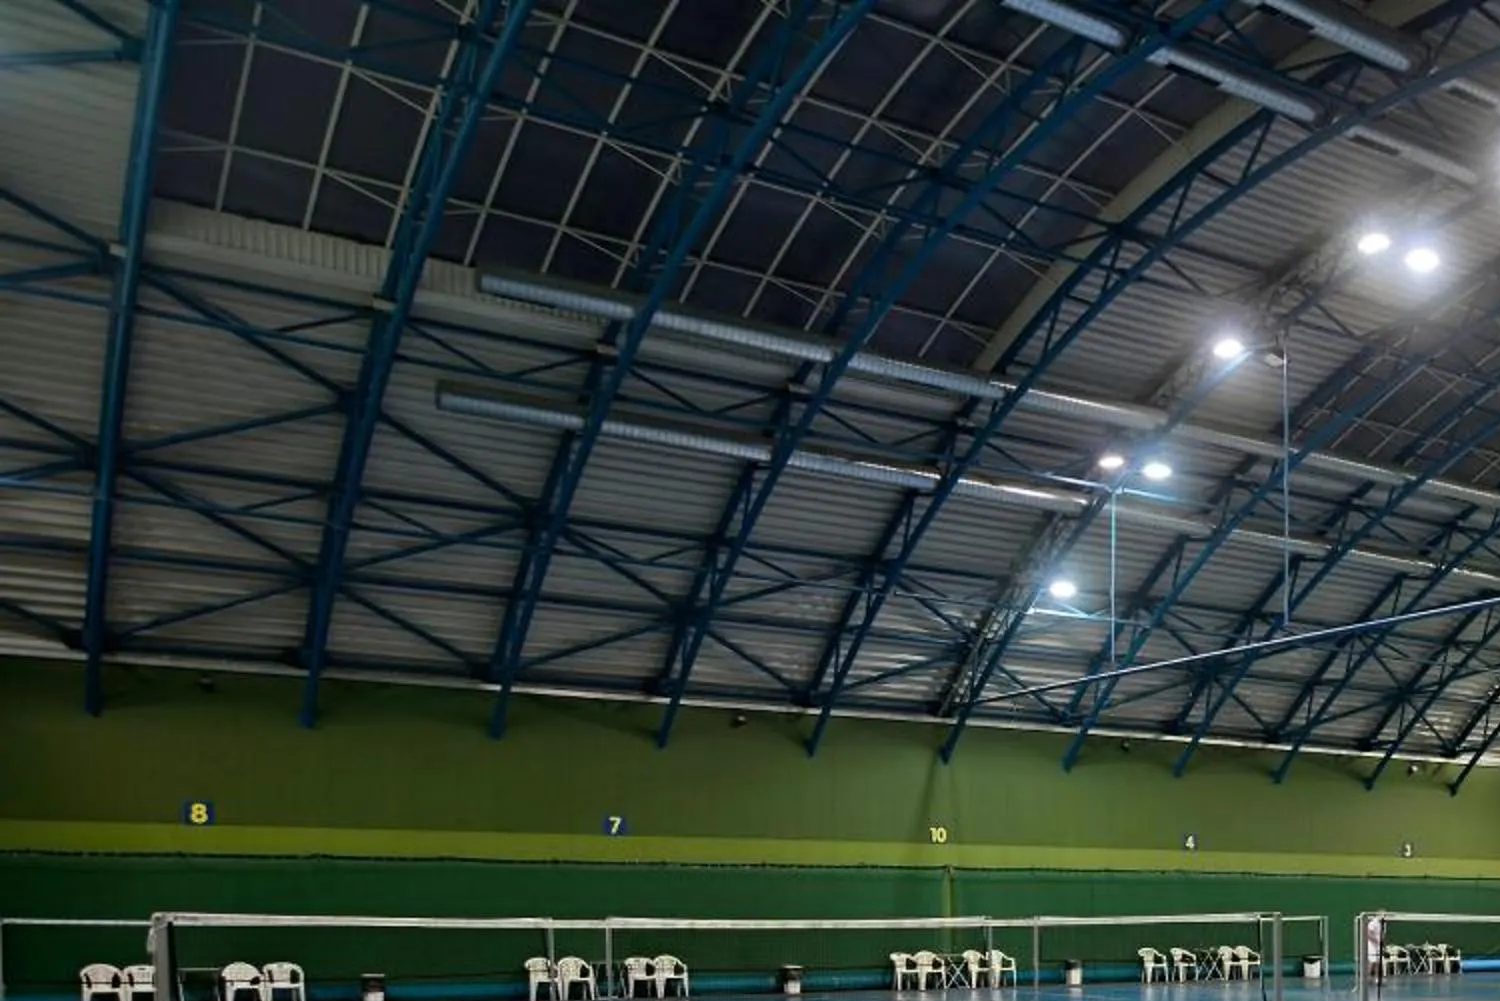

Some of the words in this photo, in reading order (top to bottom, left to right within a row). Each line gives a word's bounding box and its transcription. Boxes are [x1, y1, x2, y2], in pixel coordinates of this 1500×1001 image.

[190, 803, 209, 824] 8
[608, 817, 623, 835] 7
[929, 828, 947, 843] 10
[1185, 835, 1196, 849] 4
